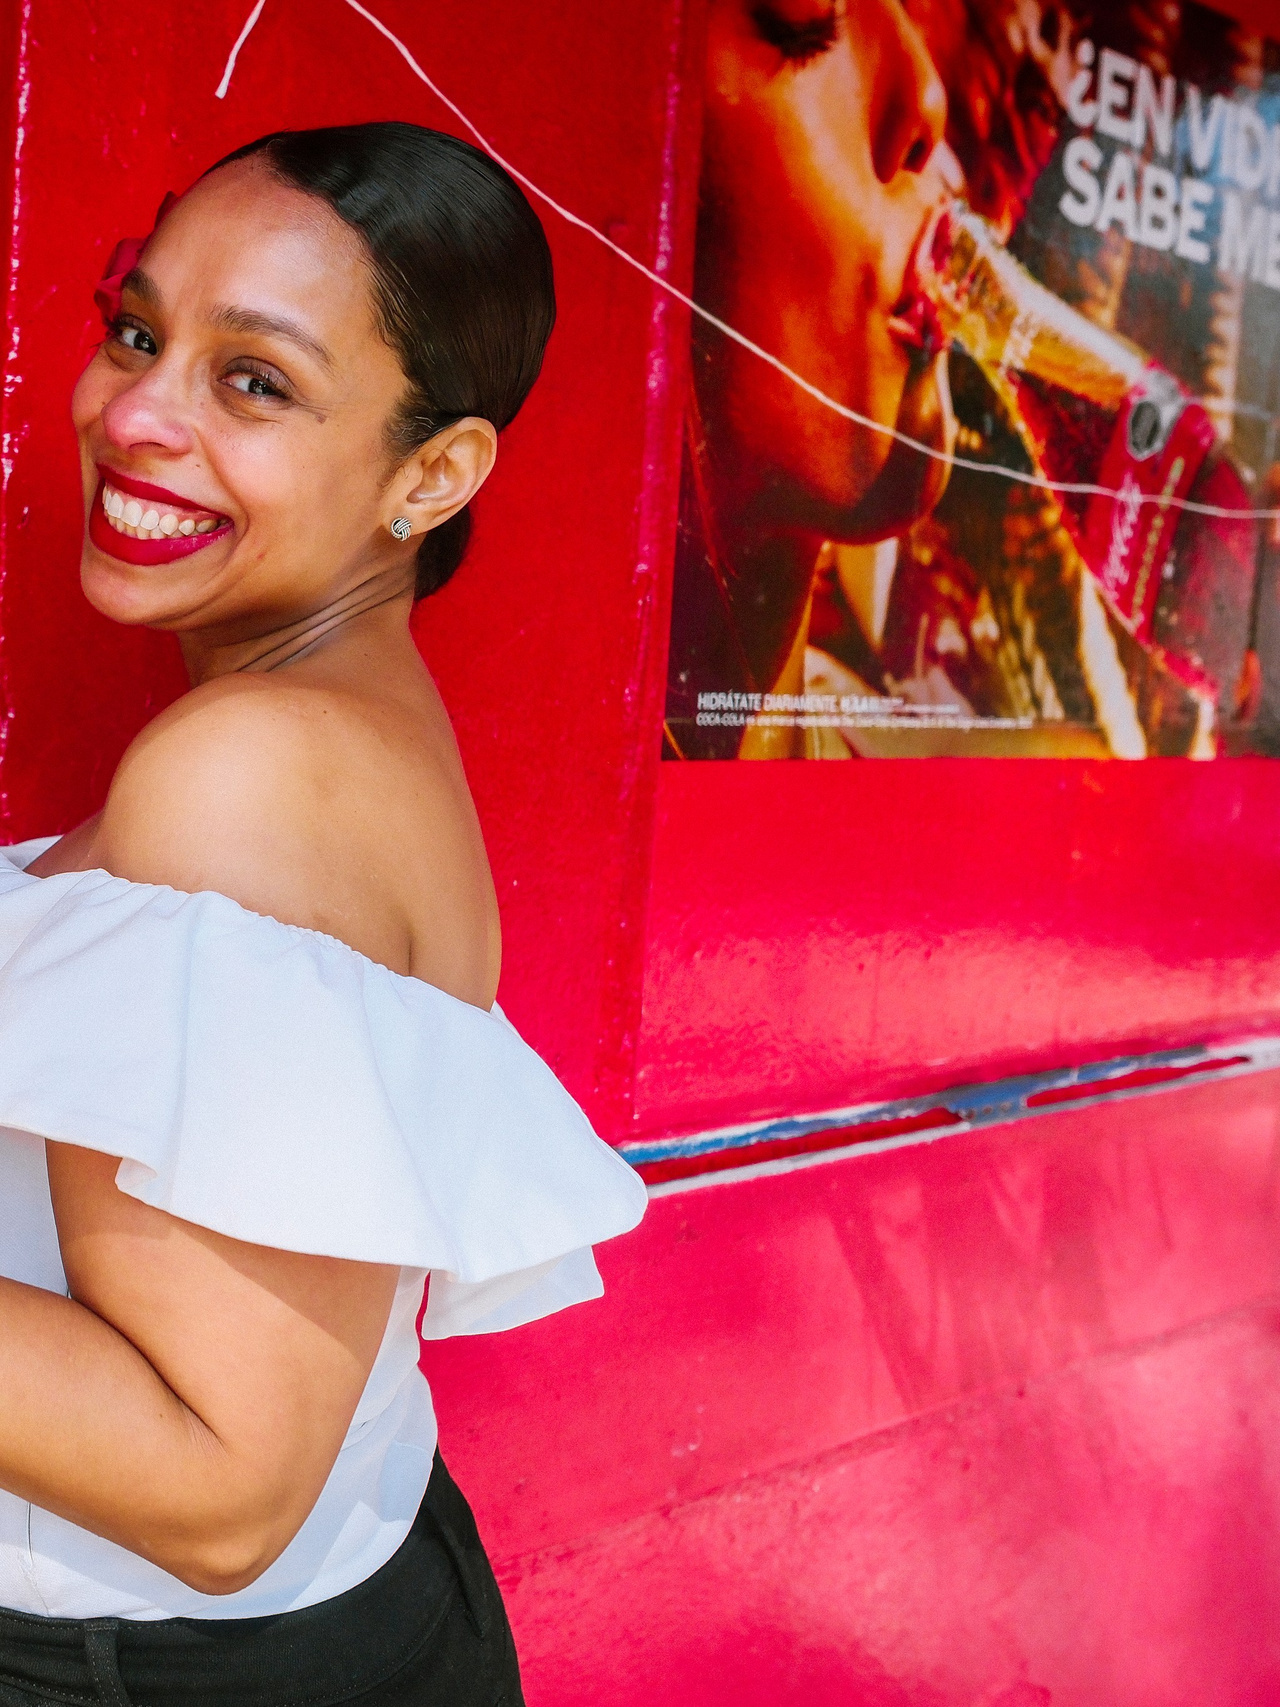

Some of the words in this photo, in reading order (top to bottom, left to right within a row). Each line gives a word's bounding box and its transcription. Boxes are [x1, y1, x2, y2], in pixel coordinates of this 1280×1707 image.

[1068, 38, 1177, 157] ¿EN
[1059, 136, 1215, 265] SABE
[697, 690, 762, 711] HIDRÁTATE
